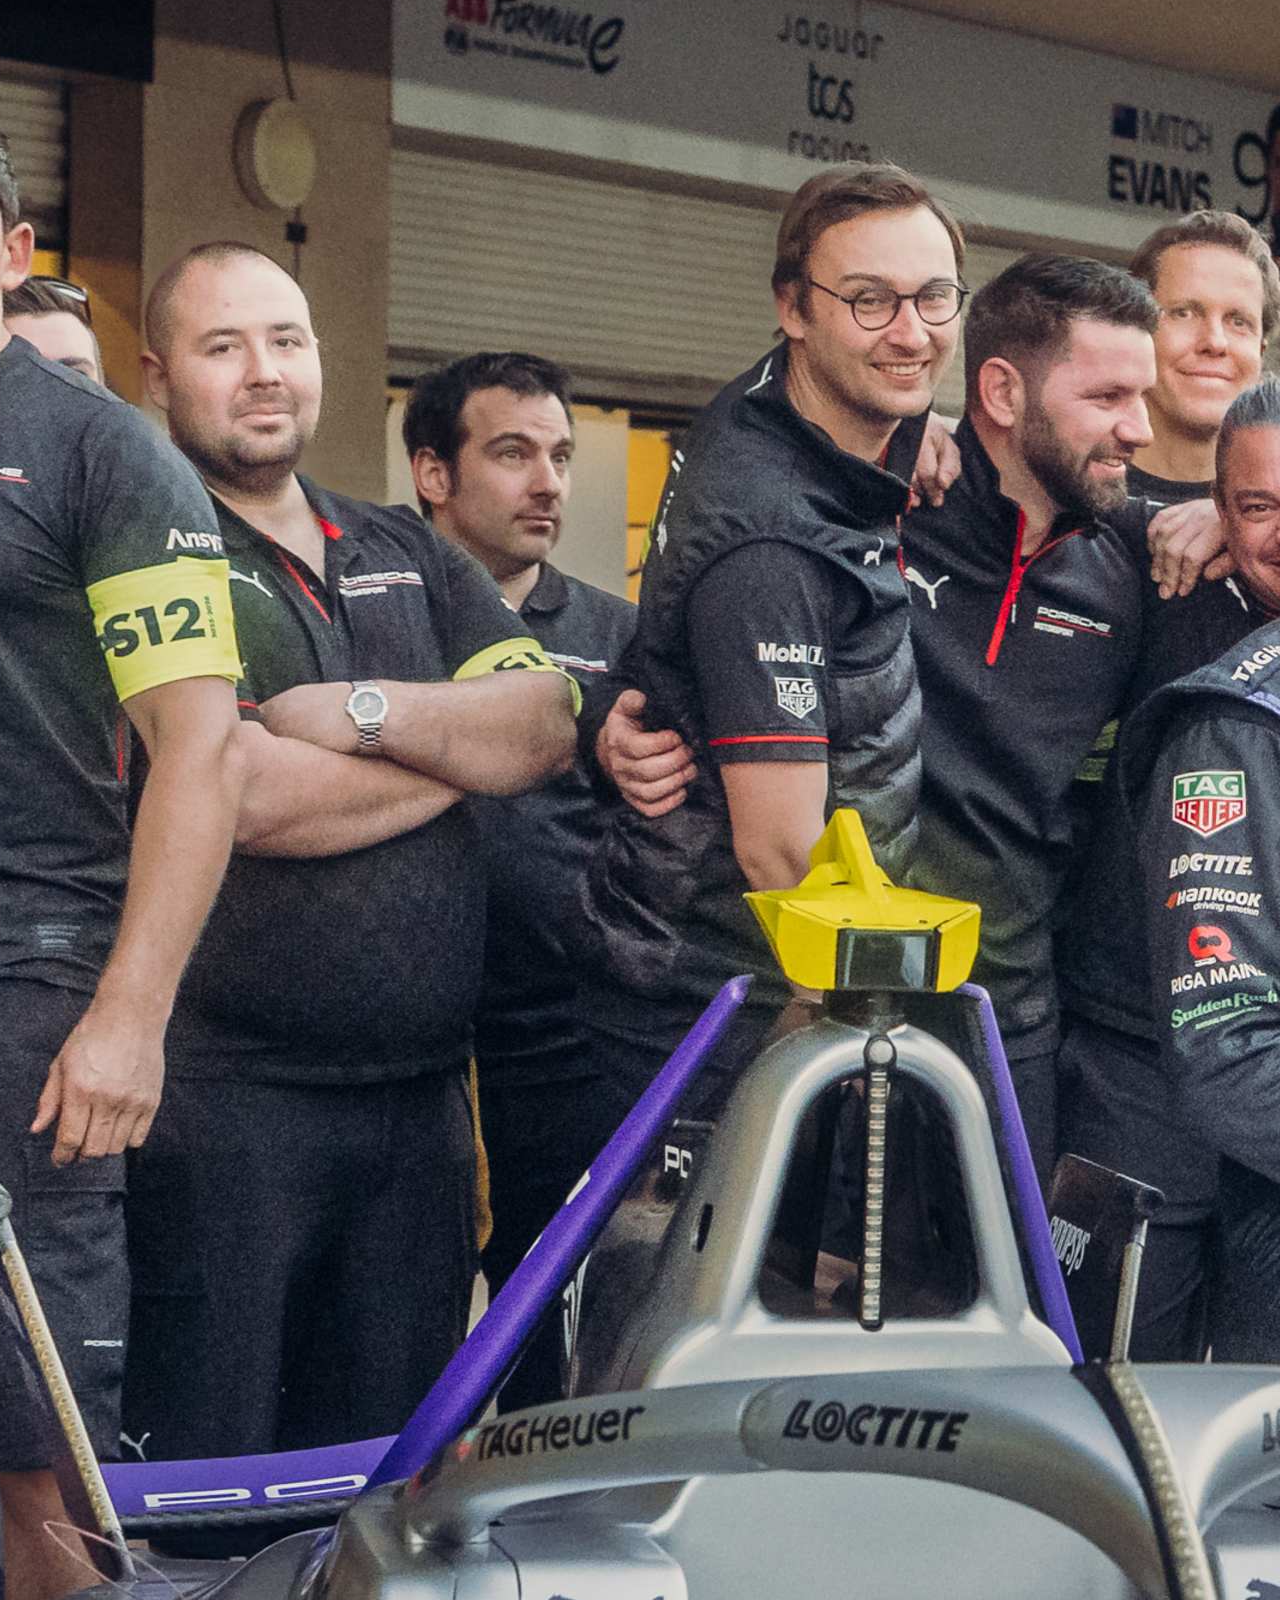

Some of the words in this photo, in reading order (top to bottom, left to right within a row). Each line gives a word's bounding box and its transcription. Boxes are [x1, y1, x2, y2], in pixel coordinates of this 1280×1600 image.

[1107, 153, 1213, 215] EVANS
[778, 680, 814, 695] TAG
[1178, 775, 1242, 797] TAG
[1175, 801, 1244, 834] HEUER
[1171, 971, 1207, 996] RIGA
[782, 1400, 971, 1453] LOCTITE
